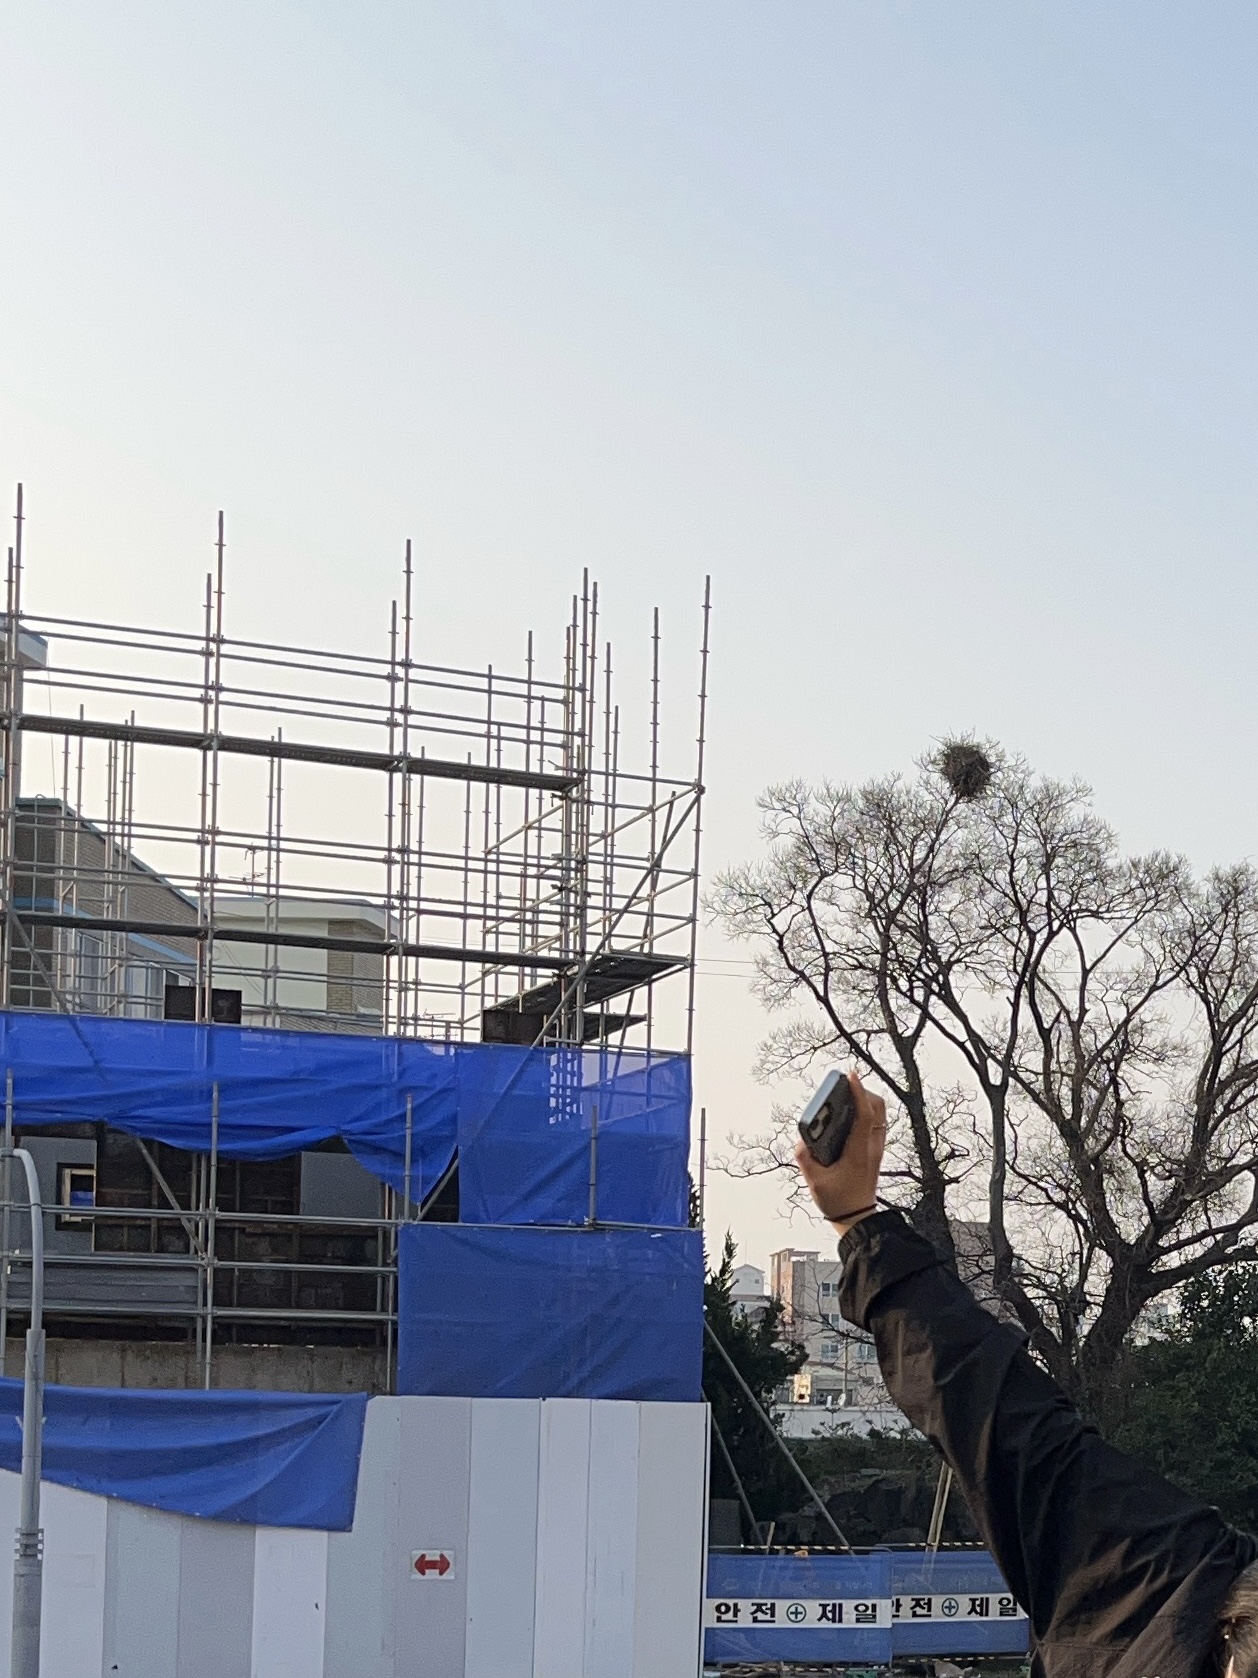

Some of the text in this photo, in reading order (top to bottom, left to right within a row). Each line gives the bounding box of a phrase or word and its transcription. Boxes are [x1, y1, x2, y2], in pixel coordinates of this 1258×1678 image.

[714, 1601, 878, 1624] 안전 제일
[967, 1596, 1018, 1618] 제일
